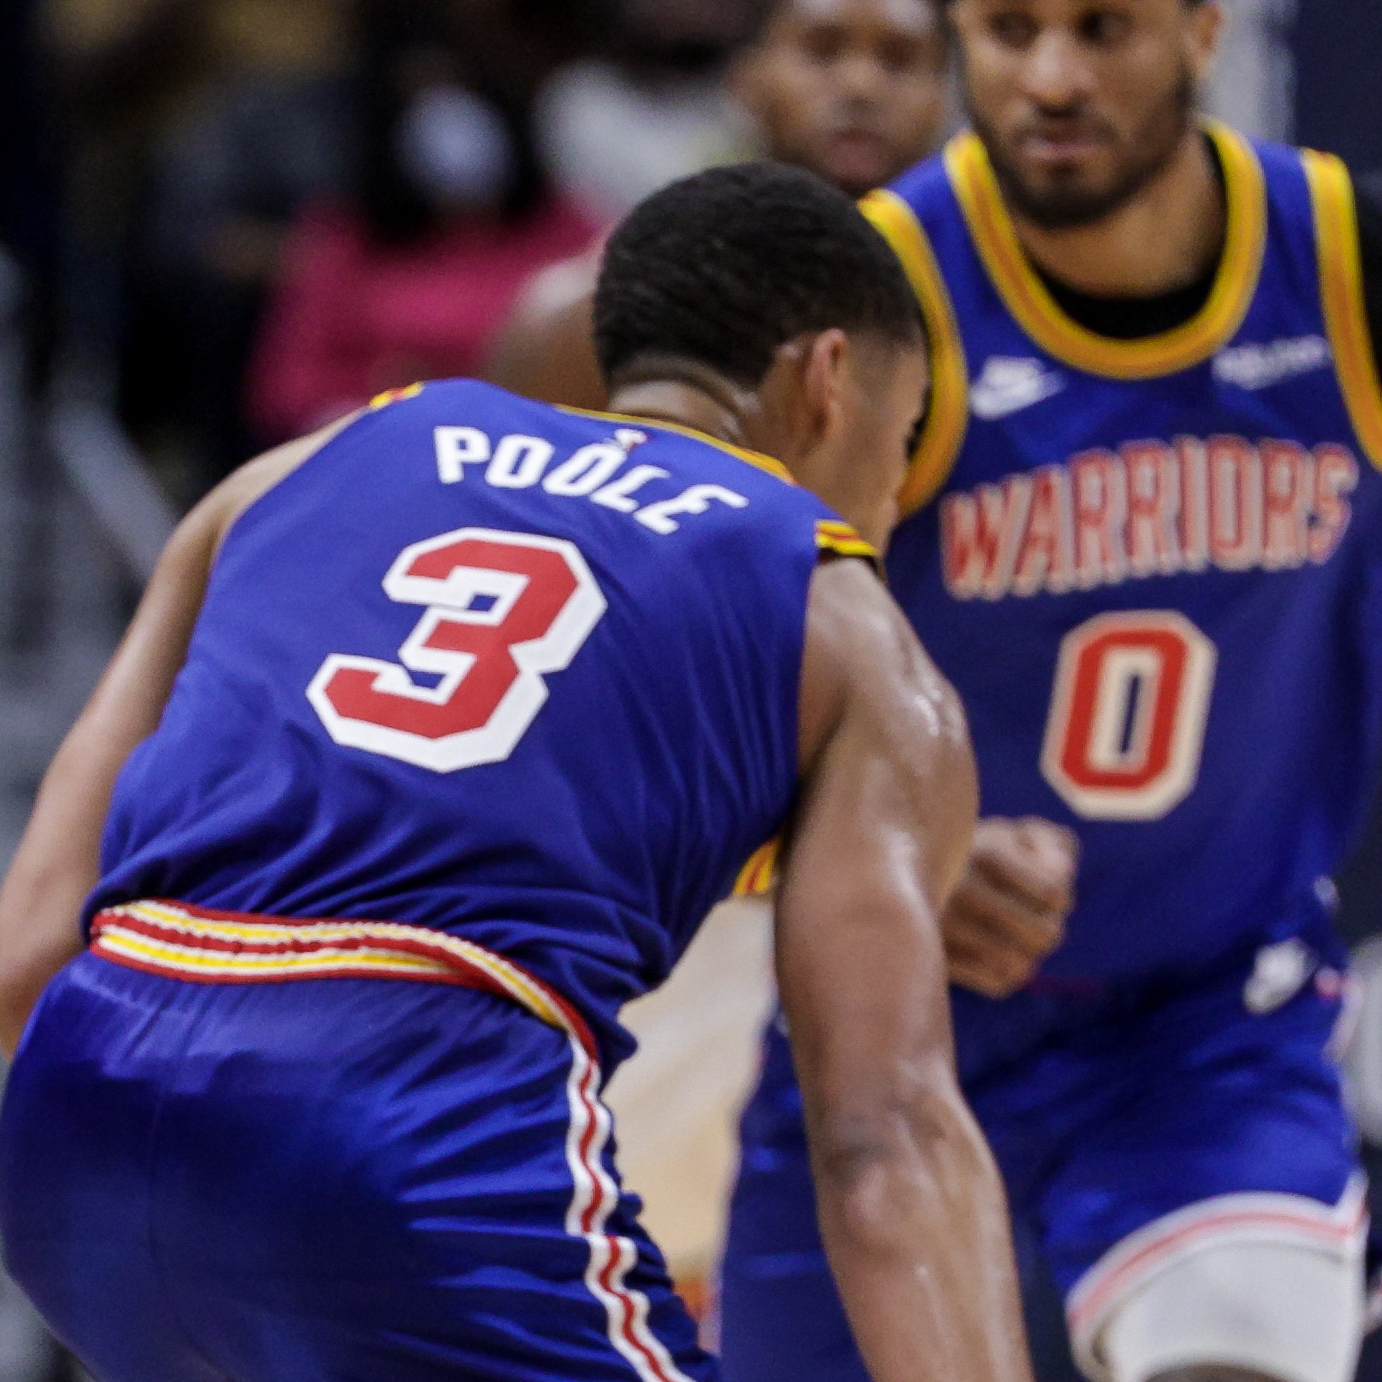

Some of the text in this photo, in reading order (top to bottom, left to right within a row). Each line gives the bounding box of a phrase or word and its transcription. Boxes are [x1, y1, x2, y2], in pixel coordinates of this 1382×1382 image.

[434, 426, 749, 535] POOLE
[941, 434, 1359, 600] WARRIORS
[305, 526, 607, 773] 3
[1039, 609, 1218, 821] 0
